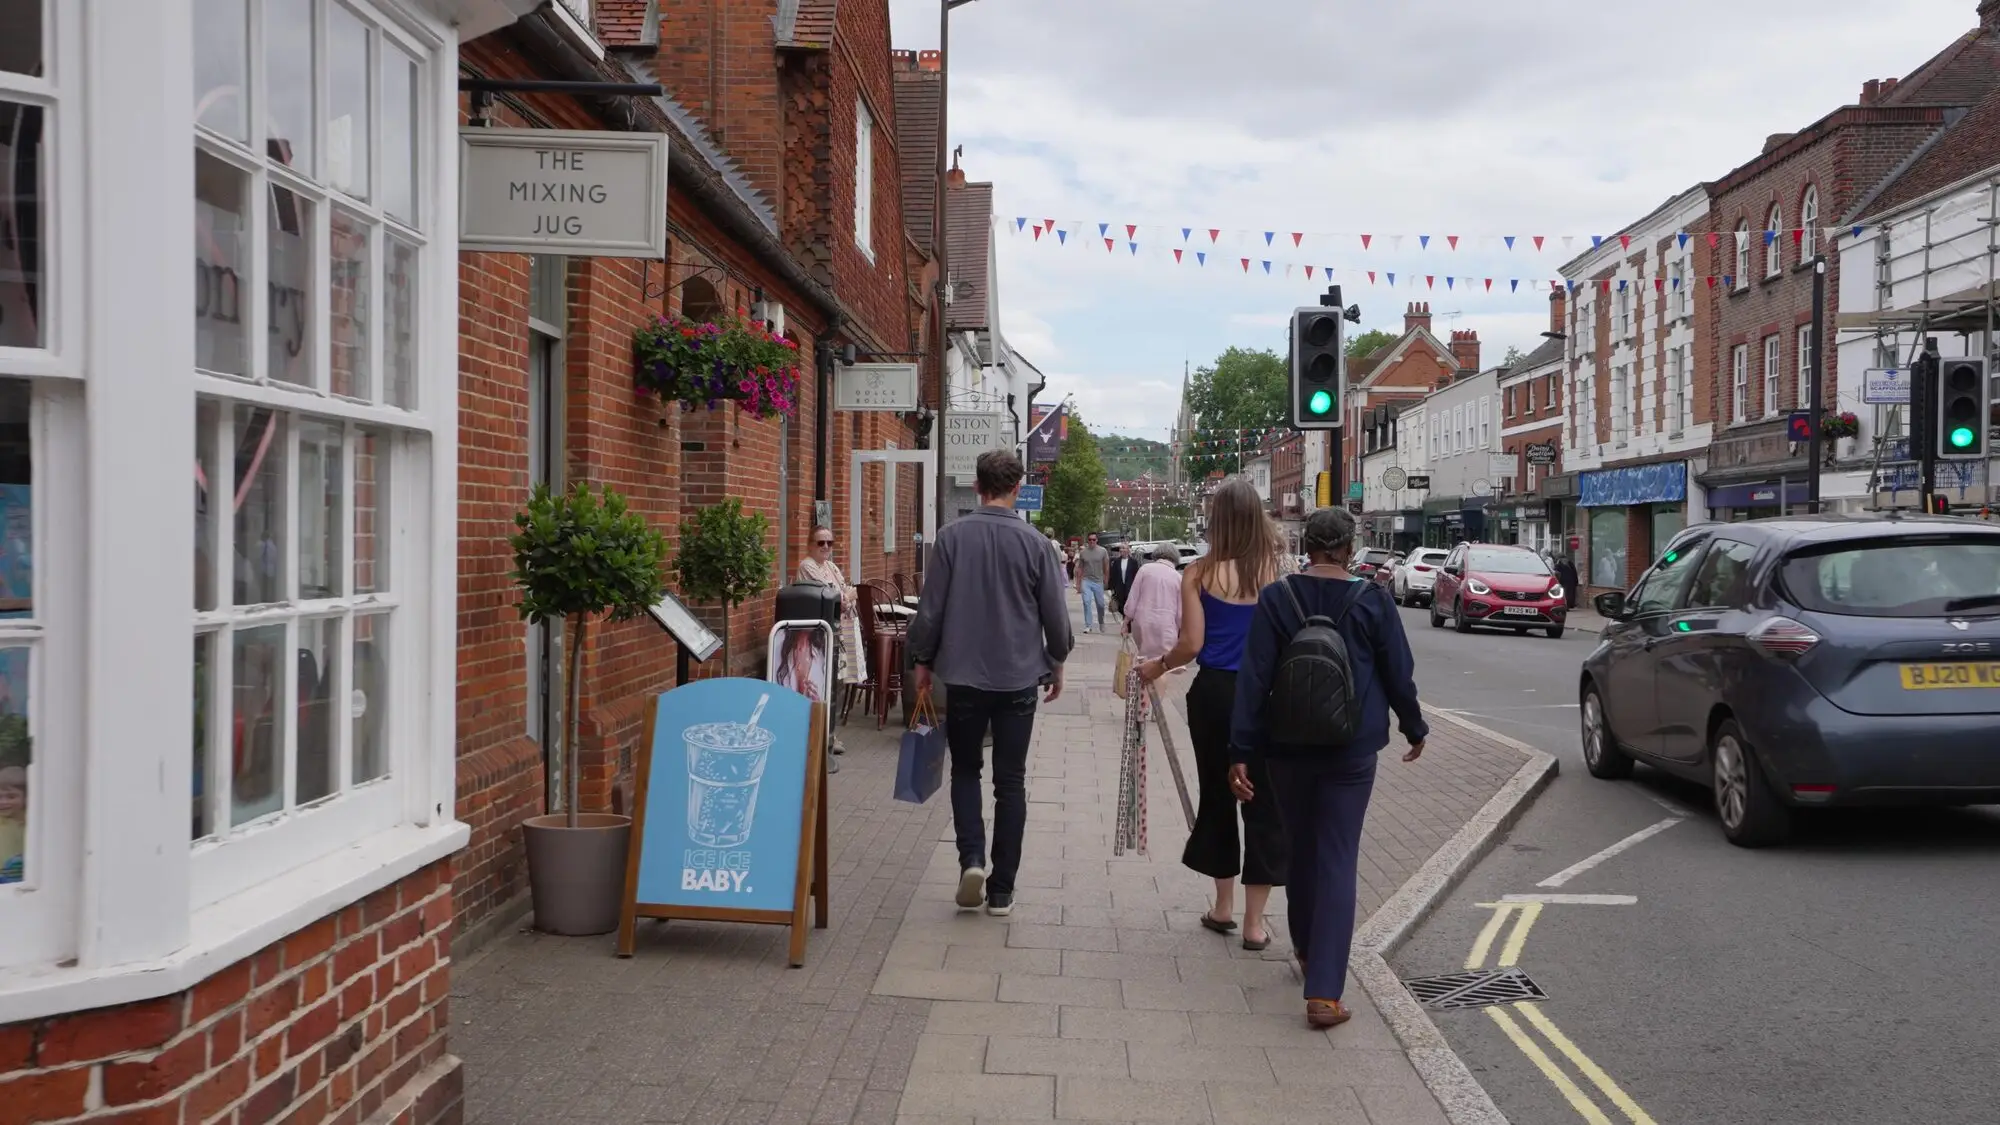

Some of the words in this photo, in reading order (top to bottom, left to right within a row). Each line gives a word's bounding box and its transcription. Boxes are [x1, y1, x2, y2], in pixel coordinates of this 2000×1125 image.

[535, 150, 584, 171] THE
[509, 181, 608, 204] MIXING
[532, 215, 583, 235] JUG
[1942, 643, 1990, 653] ZOE
[1910, 665, 1970, 685] BJ20
[684, 849, 716, 869] ICE
[719, 850, 751, 870] ICE
[681, 868, 753, 892] BABY.
